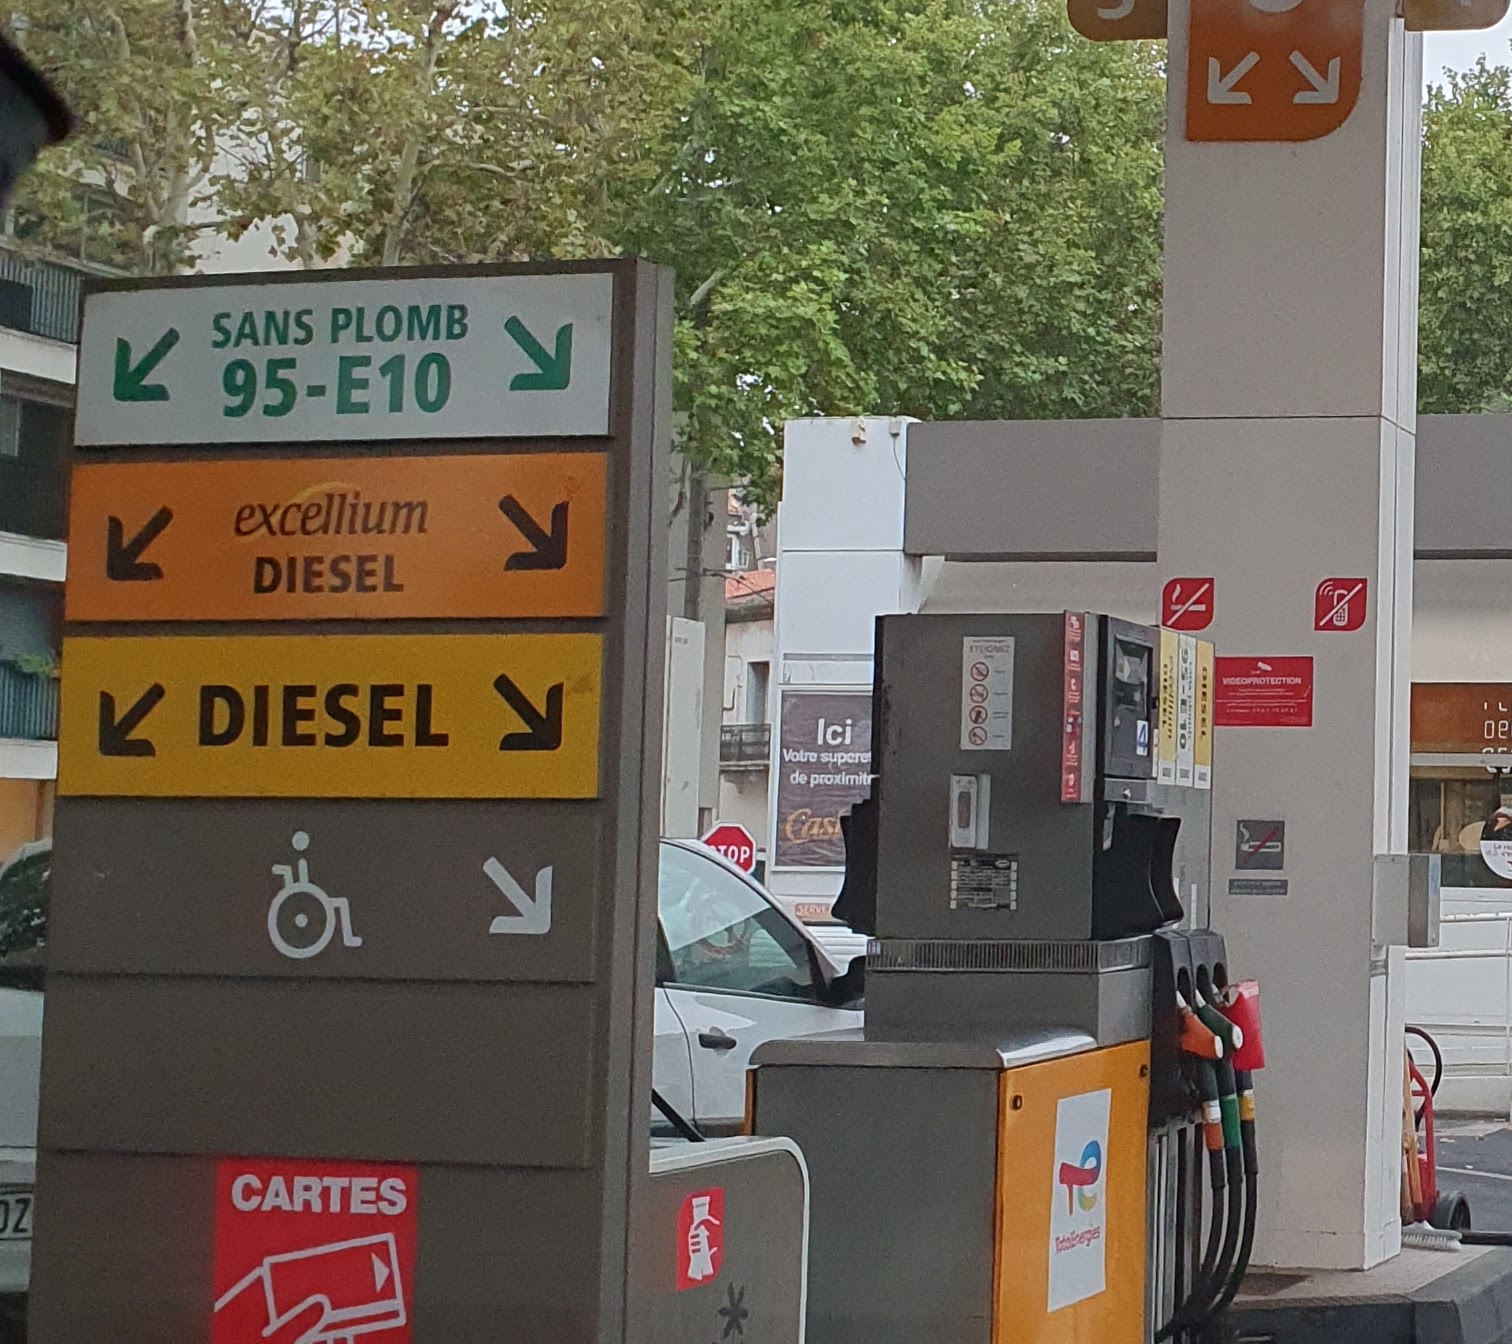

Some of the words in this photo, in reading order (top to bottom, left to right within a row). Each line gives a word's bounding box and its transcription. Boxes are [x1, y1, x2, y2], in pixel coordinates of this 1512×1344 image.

[211, 309, 314, 349] SANS
[330, 304, 469, 344] PLOMB
[222, 352, 451, 417] 95-E10
[234, 490, 429, 538] excellium
[253, 554, 405, 594] DIESEL
[199, 683, 450, 748] DIESEL
[817, 718, 852, 745] Ici
[782, 748, 817, 762] Votre
[1136, 723, 1148, 754] 4
[790, 770, 808, 784] de
[711, 845, 750, 863] TOP
[231, 1174, 407, 1216] CARTES
